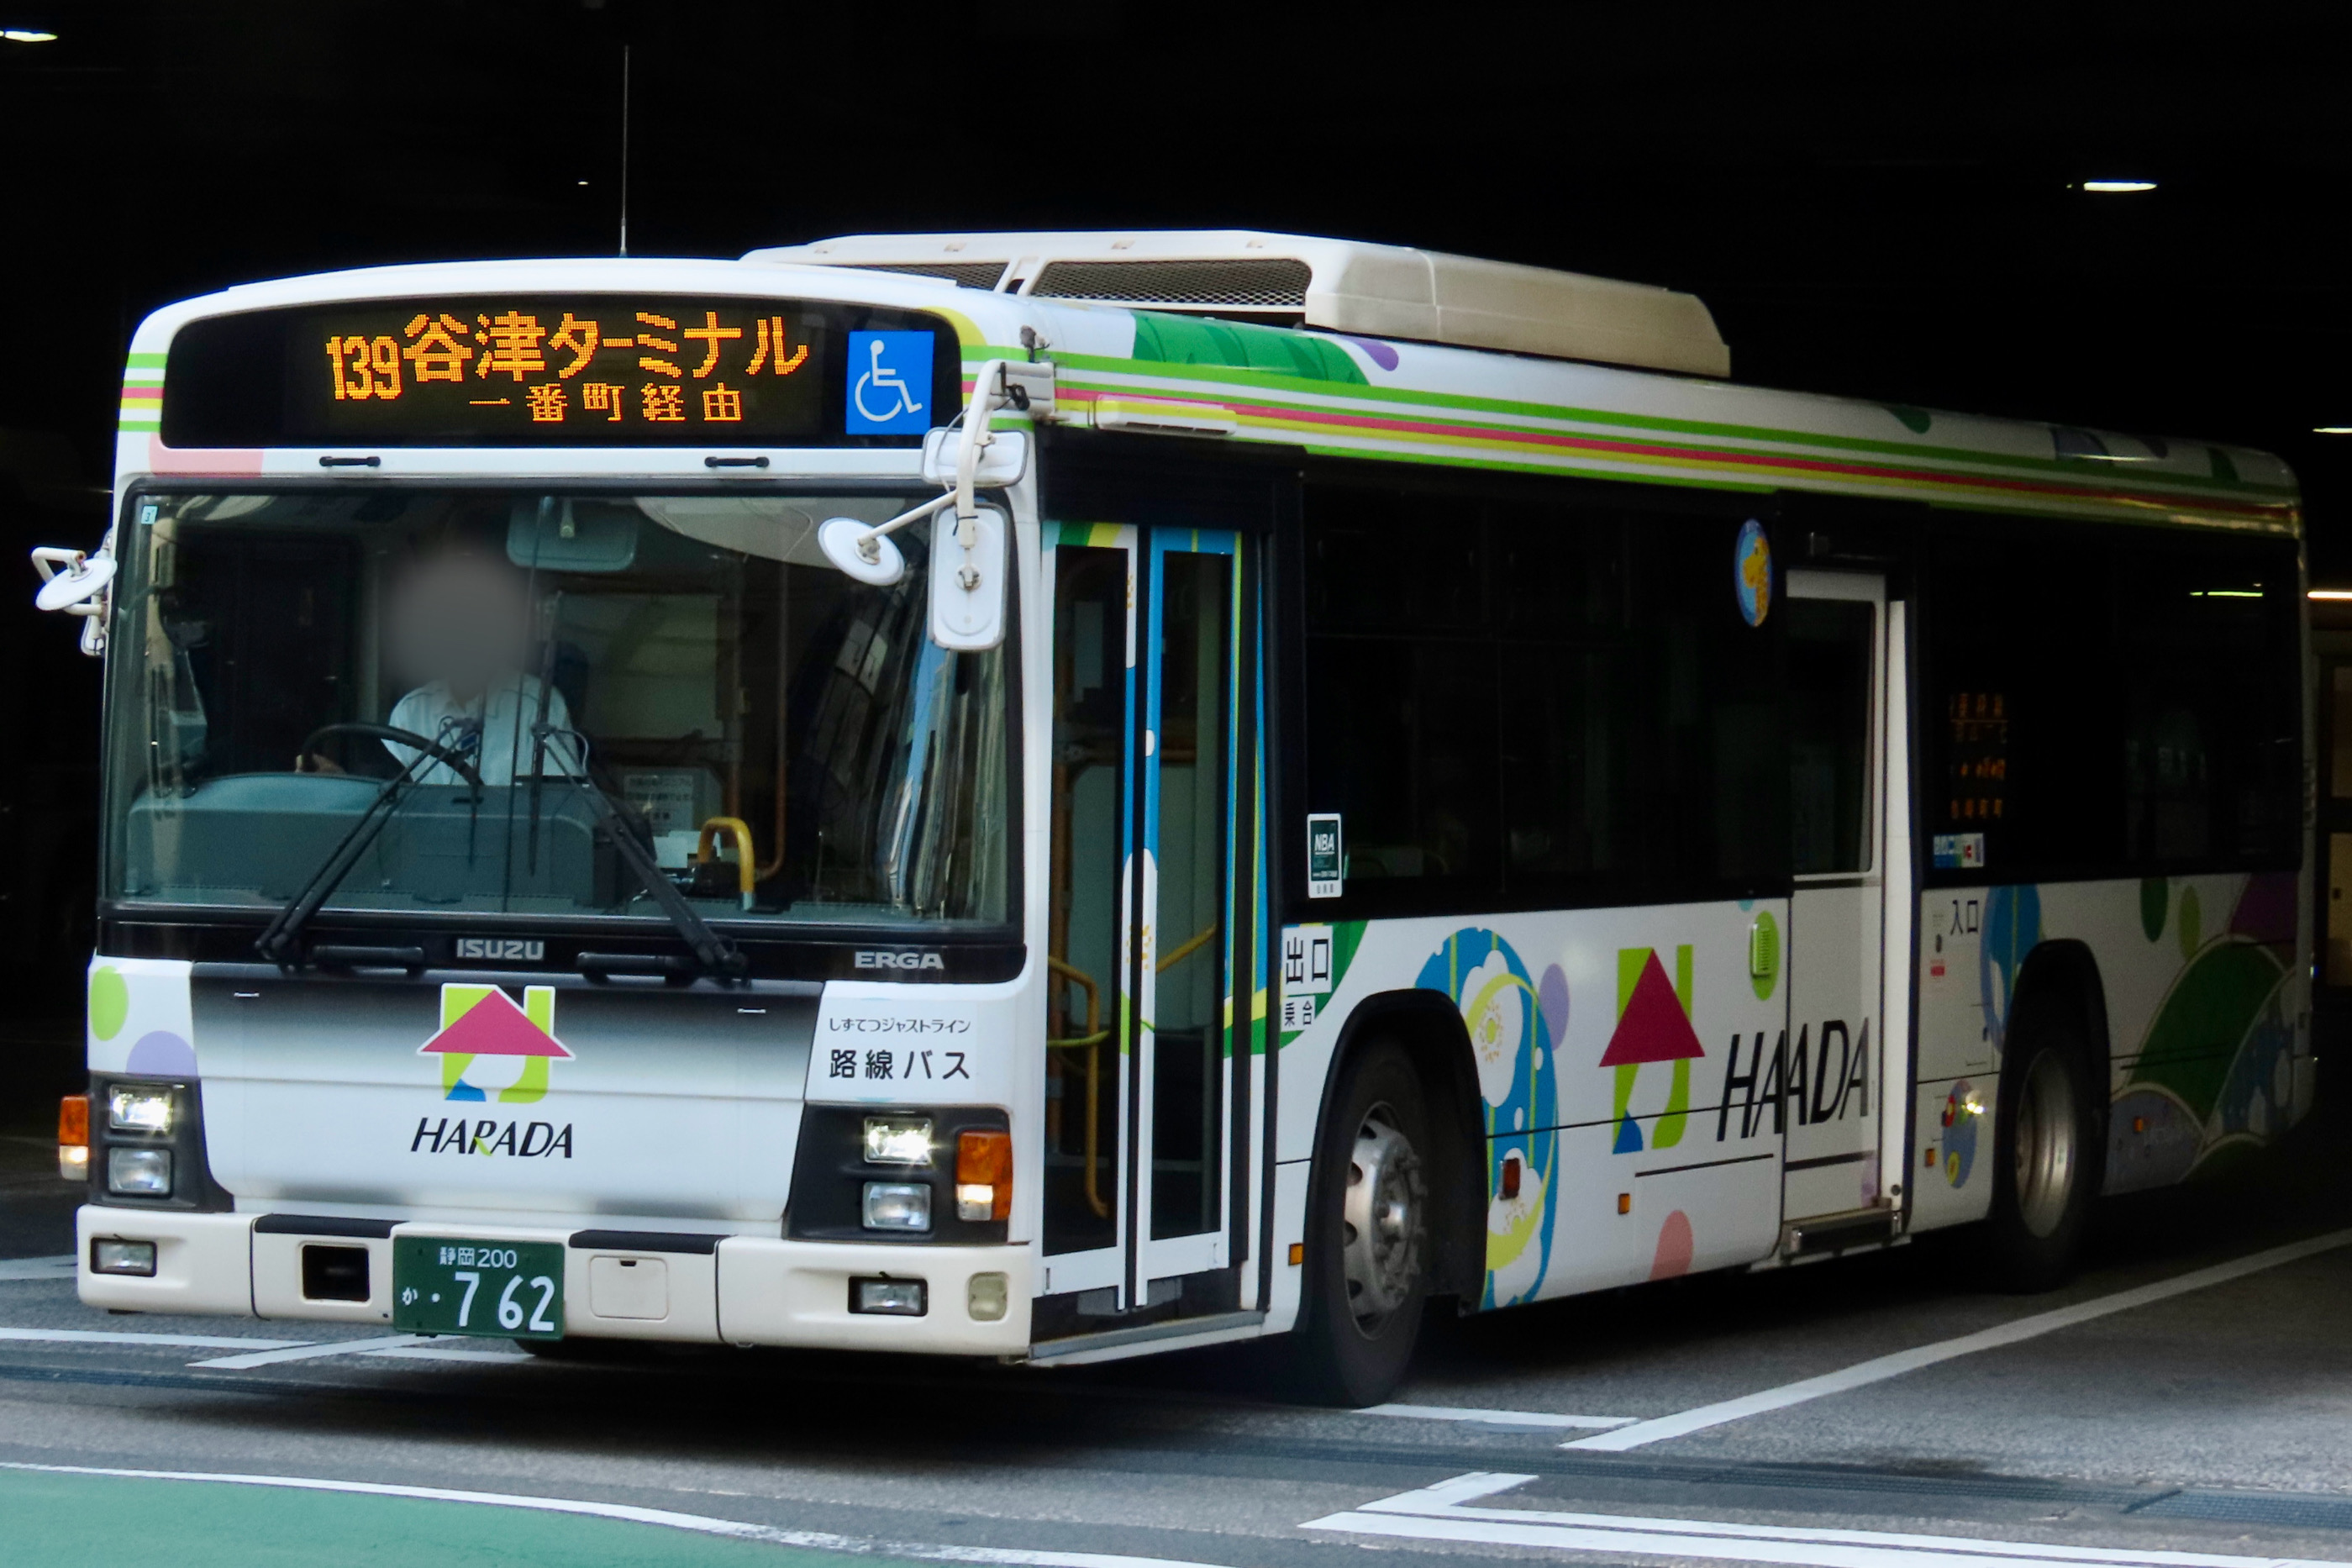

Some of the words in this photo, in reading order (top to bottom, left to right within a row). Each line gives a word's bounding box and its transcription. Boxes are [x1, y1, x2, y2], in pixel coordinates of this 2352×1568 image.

[326, 336, 403, 401] 139
[403, 310, 808, 381] 谷津ターミナル
[469, 382, 743, 422] 一番町経由
[1949, 899, 1979, 936] 入口
[456, 939, 545, 960] ISUZU
[854, 951, 944, 970] ERGA
[1285, 937, 1329, 984] 出口
[829, 1017, 971, 1034] しずてつジャストライン
[829, 1050, 971, 1080] 路線バス
[410, 1118, 573, 1159] HARADA
